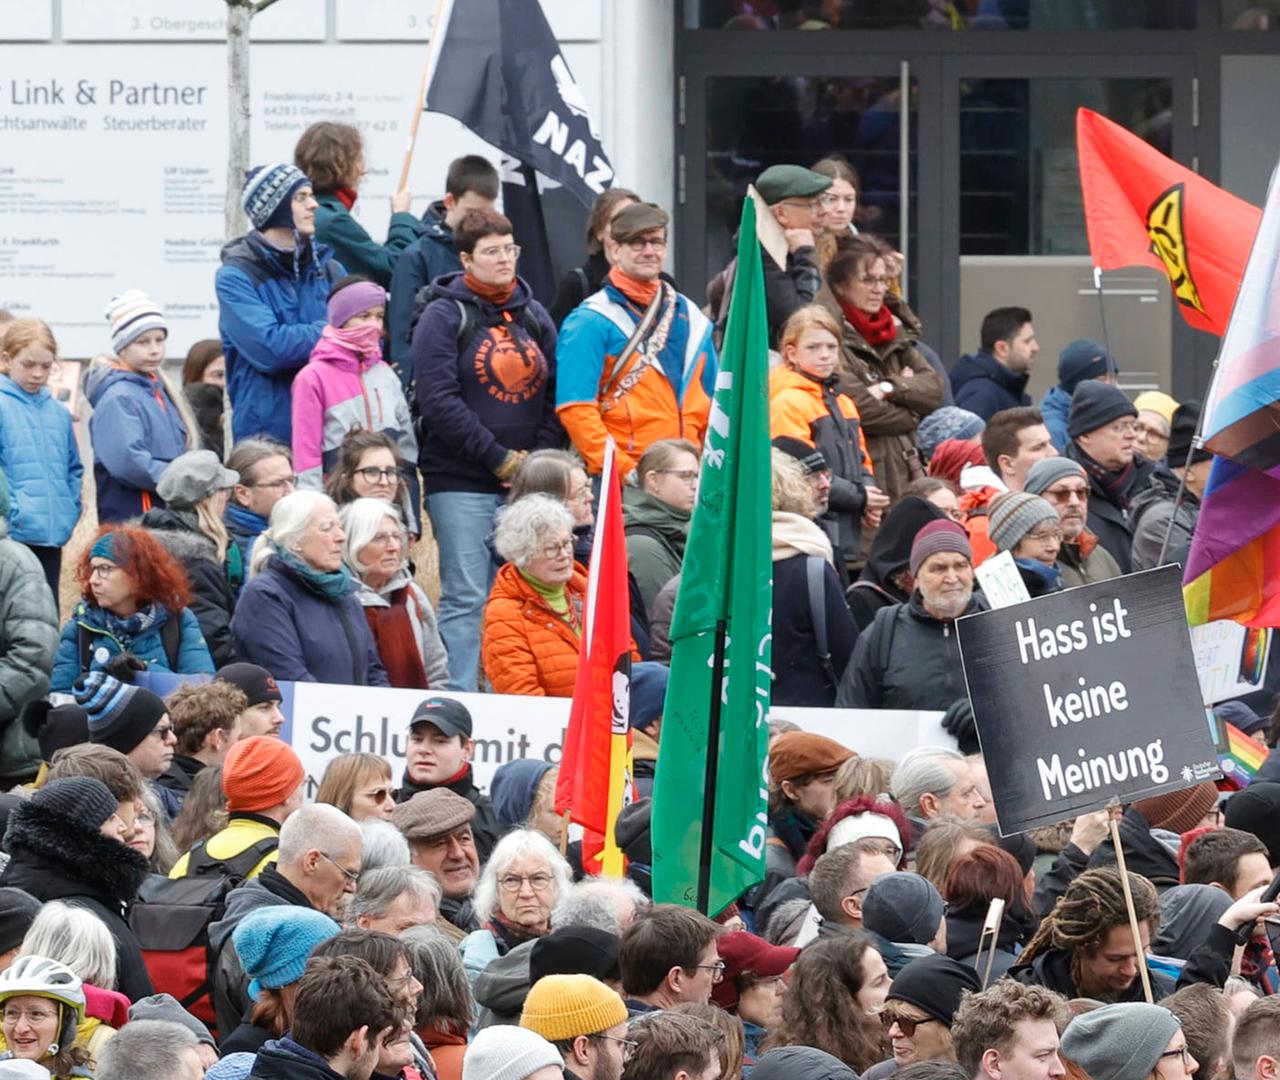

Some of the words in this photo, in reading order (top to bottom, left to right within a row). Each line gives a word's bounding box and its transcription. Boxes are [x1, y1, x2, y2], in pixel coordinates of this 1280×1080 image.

[11, 79, 64, 105] Link
[75, 80, 97, 106] &
[109, 80, 207, 105] Partner
[103, 116, 206, 132] Steuerberater
[533, 110, 615, 194] NAZ
[1015, 617, 1089, 665] Hass
[1088, 598, 1132, 645] ist
[1043, 676, 1130, 729] keine
[310, 715, 408, 759] Schlu
[470, 728, 531, 764] mit
[1036, 738, 1170, 801] Meinung
